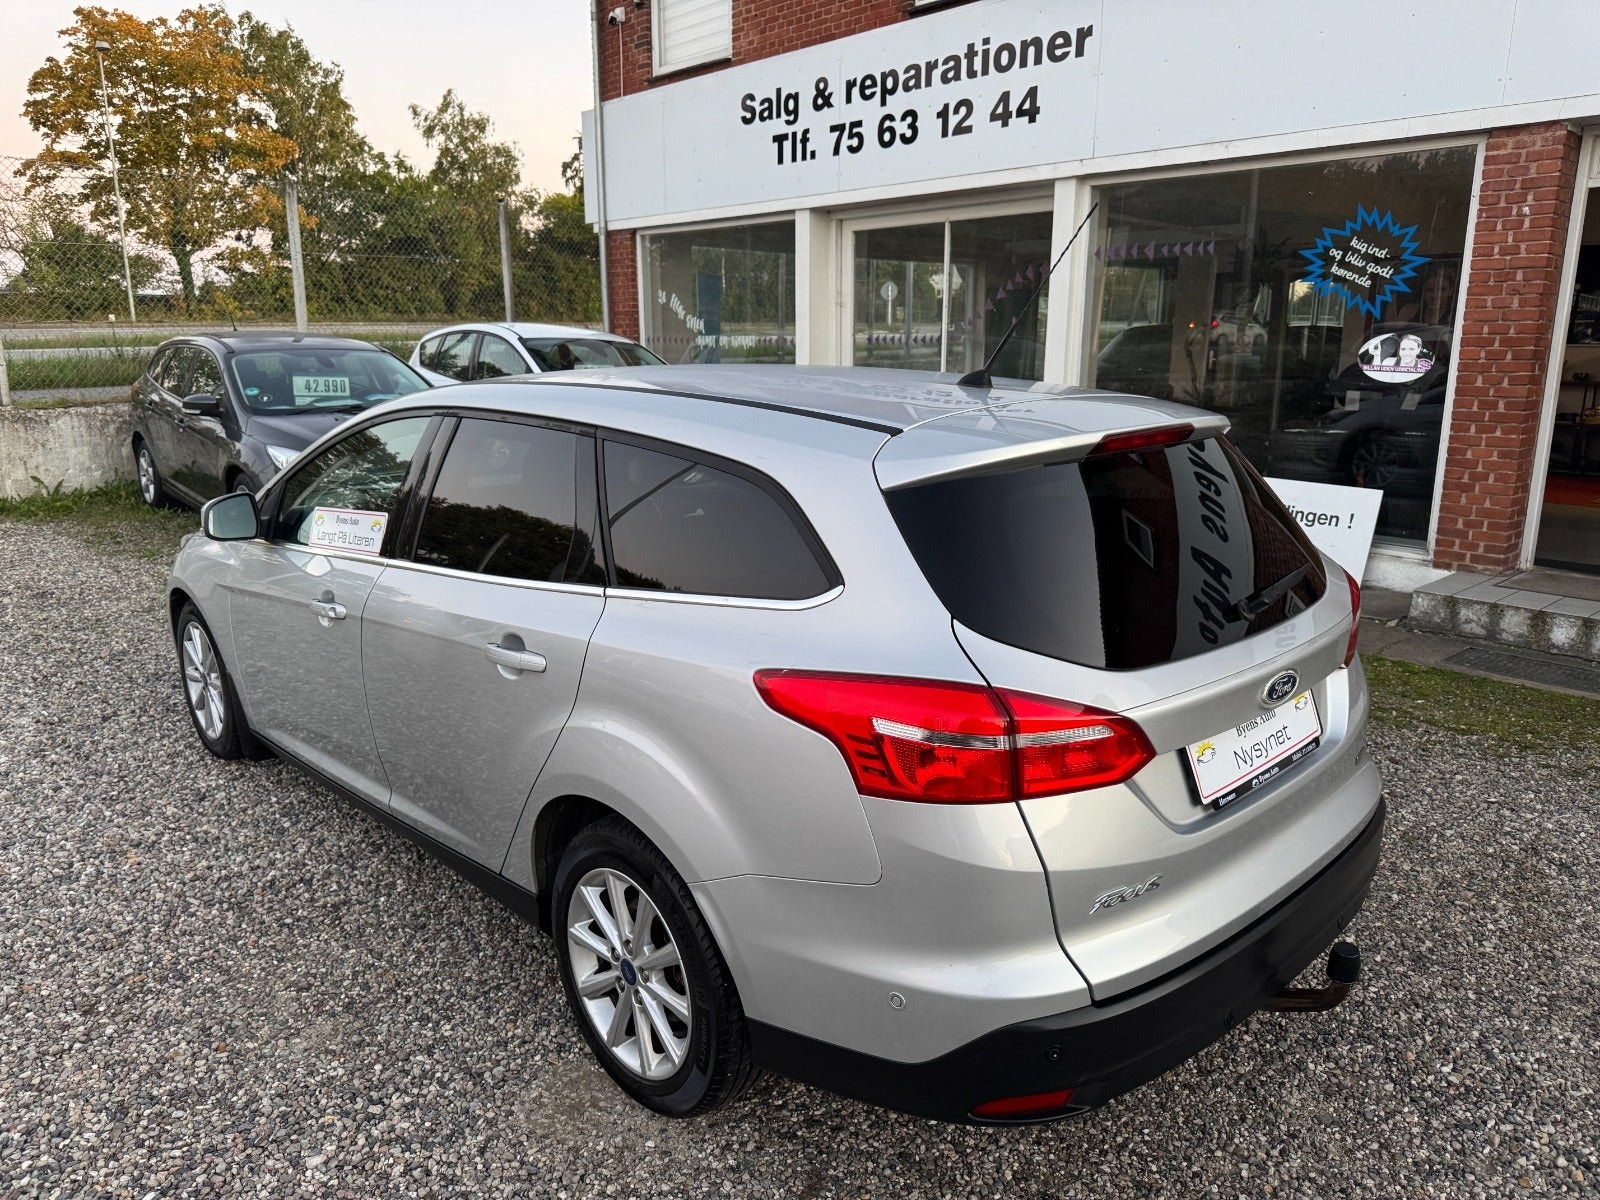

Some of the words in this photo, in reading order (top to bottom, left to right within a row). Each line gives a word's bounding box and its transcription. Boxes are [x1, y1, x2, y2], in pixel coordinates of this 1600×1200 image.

[740, 87, 799, 126] Salg
[812, 76, 834, 112] &
[845, 24, 1093, 107] reparationer
[772, 128, 816, 166] Tlf.
[829, 119, 864, 157] 75
[877, 109, 919, 149] 63
[936, 98, 974, 139] 12
[989, 86, 1041, 128] 44
[1350, 236, 1367, 254] kig
[1329, 248, 1343, 262] og
[1345, 249, 1366, 268] bliv
[1366, 262, 1395, 279] godt
[1330, 263, 1372, 288] kørende
[304, 379, 346, 393] 42.990
[1347, 513, 1355, 529] !
[317, 529, 337, 544] Langt
[338, 530, 347, 544] På
[348, 532, 375, 548] Literen
[1273, 678, 1293, 699] Ford
[1235, 718, 1259, 738] Byens
[1260, 709, 1276, 726] Auto
[1233, 724, 1292, 770] Nysynet
[1088, 873, 1163, 915] Focus
